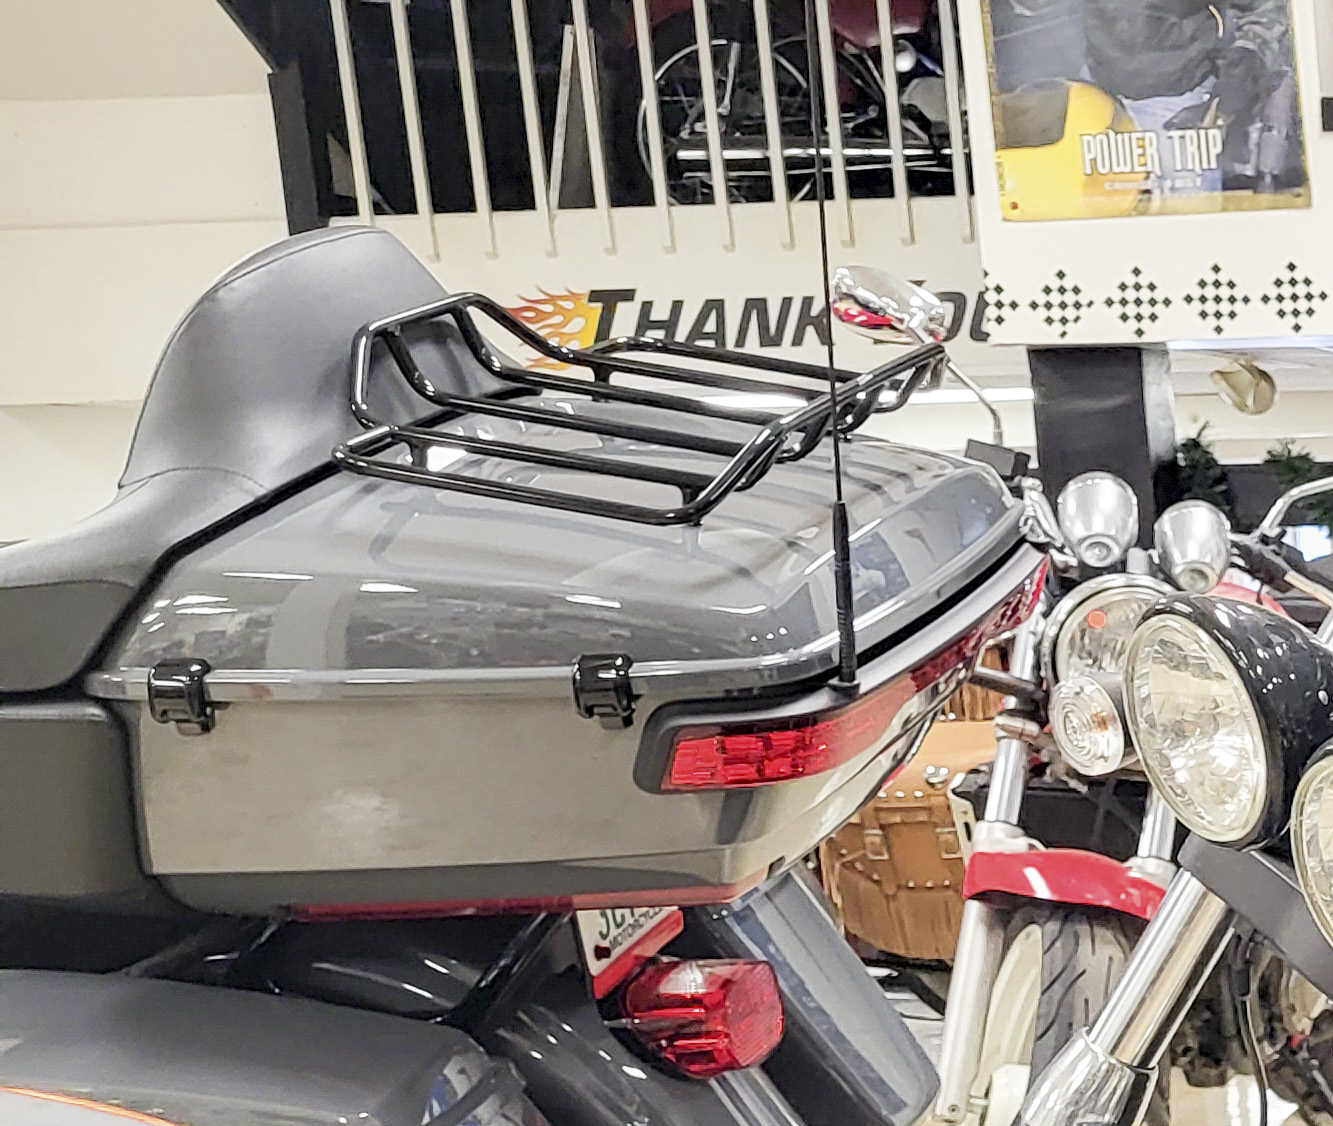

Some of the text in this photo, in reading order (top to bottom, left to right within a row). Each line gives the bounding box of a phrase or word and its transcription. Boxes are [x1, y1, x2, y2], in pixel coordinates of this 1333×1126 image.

[1080, 128, 1223, 177] POWER TRIP
[588, 288, 835, 349] THANK
